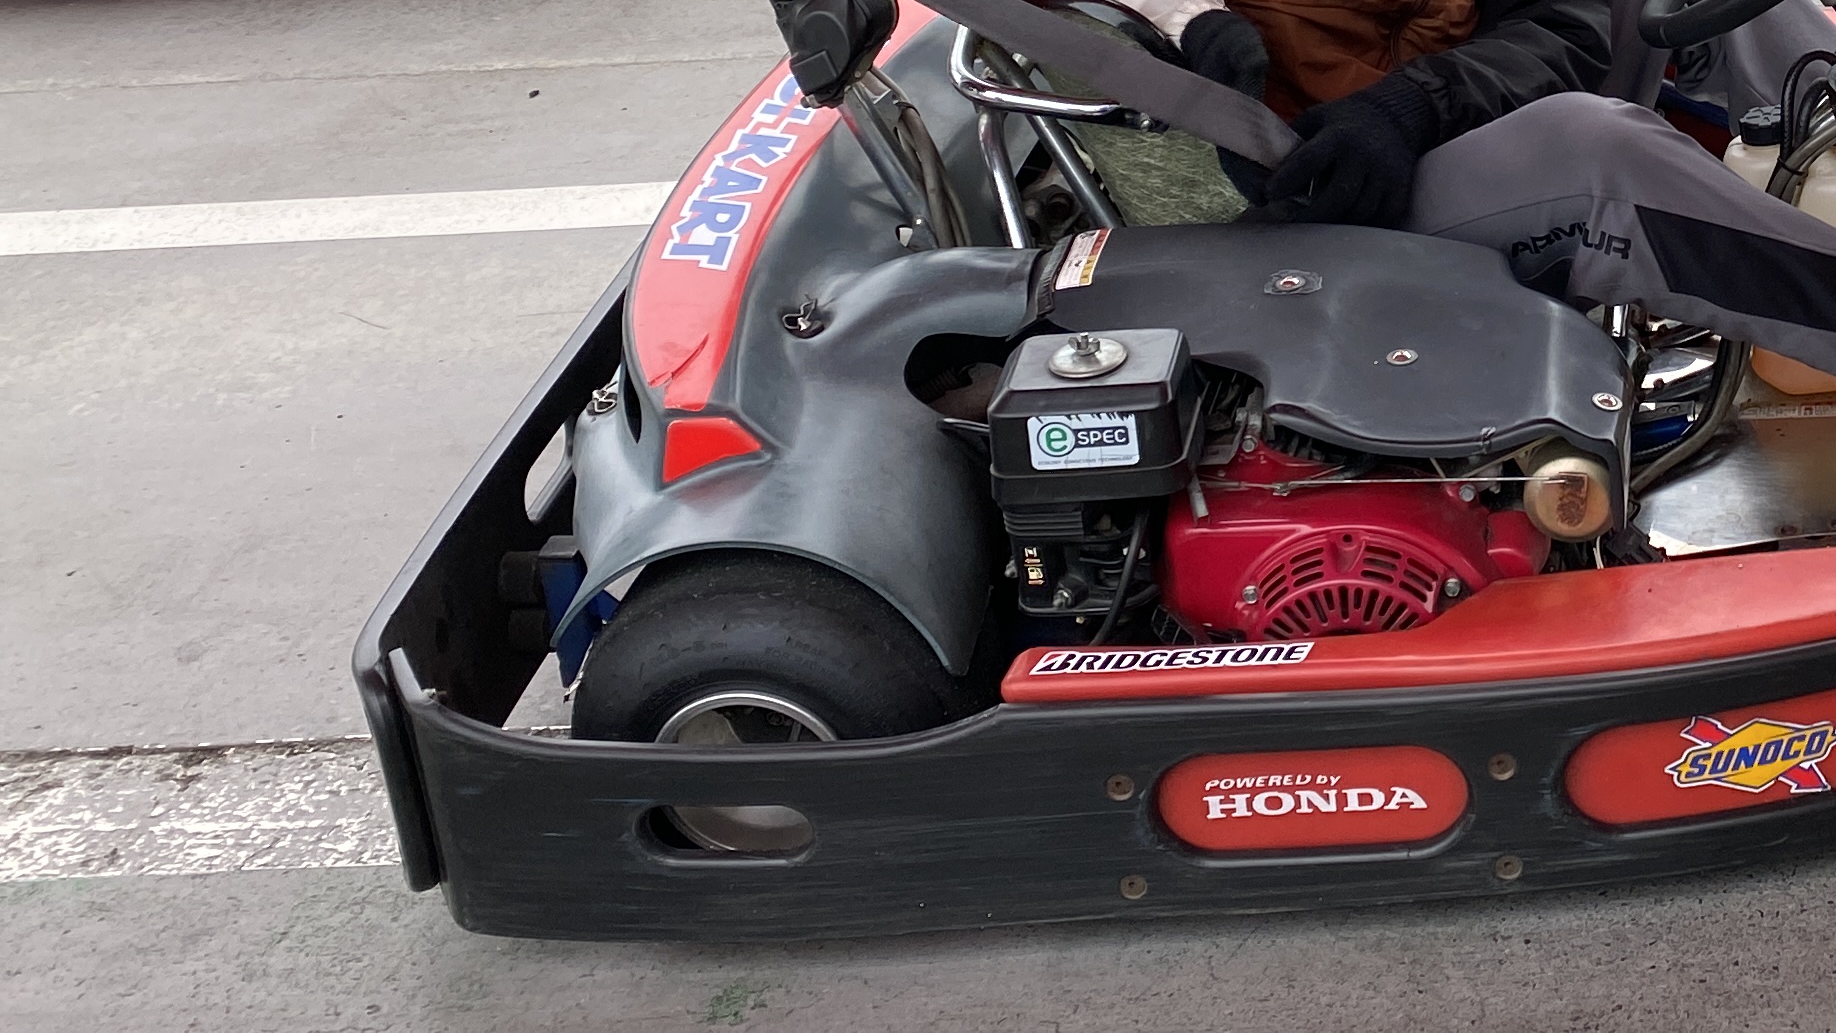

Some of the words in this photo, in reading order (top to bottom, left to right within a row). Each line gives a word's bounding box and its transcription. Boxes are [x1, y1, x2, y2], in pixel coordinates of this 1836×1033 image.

[1077, 428, 1127, 445] SPEC
[1035, 643, 1309, 673] BRIDGESTONE
[1685, 729, 1831, 779] SUNOCO
[1204, 774, 1312, 791] POWERED
[1202, 786, 1428, 819] HONDA
